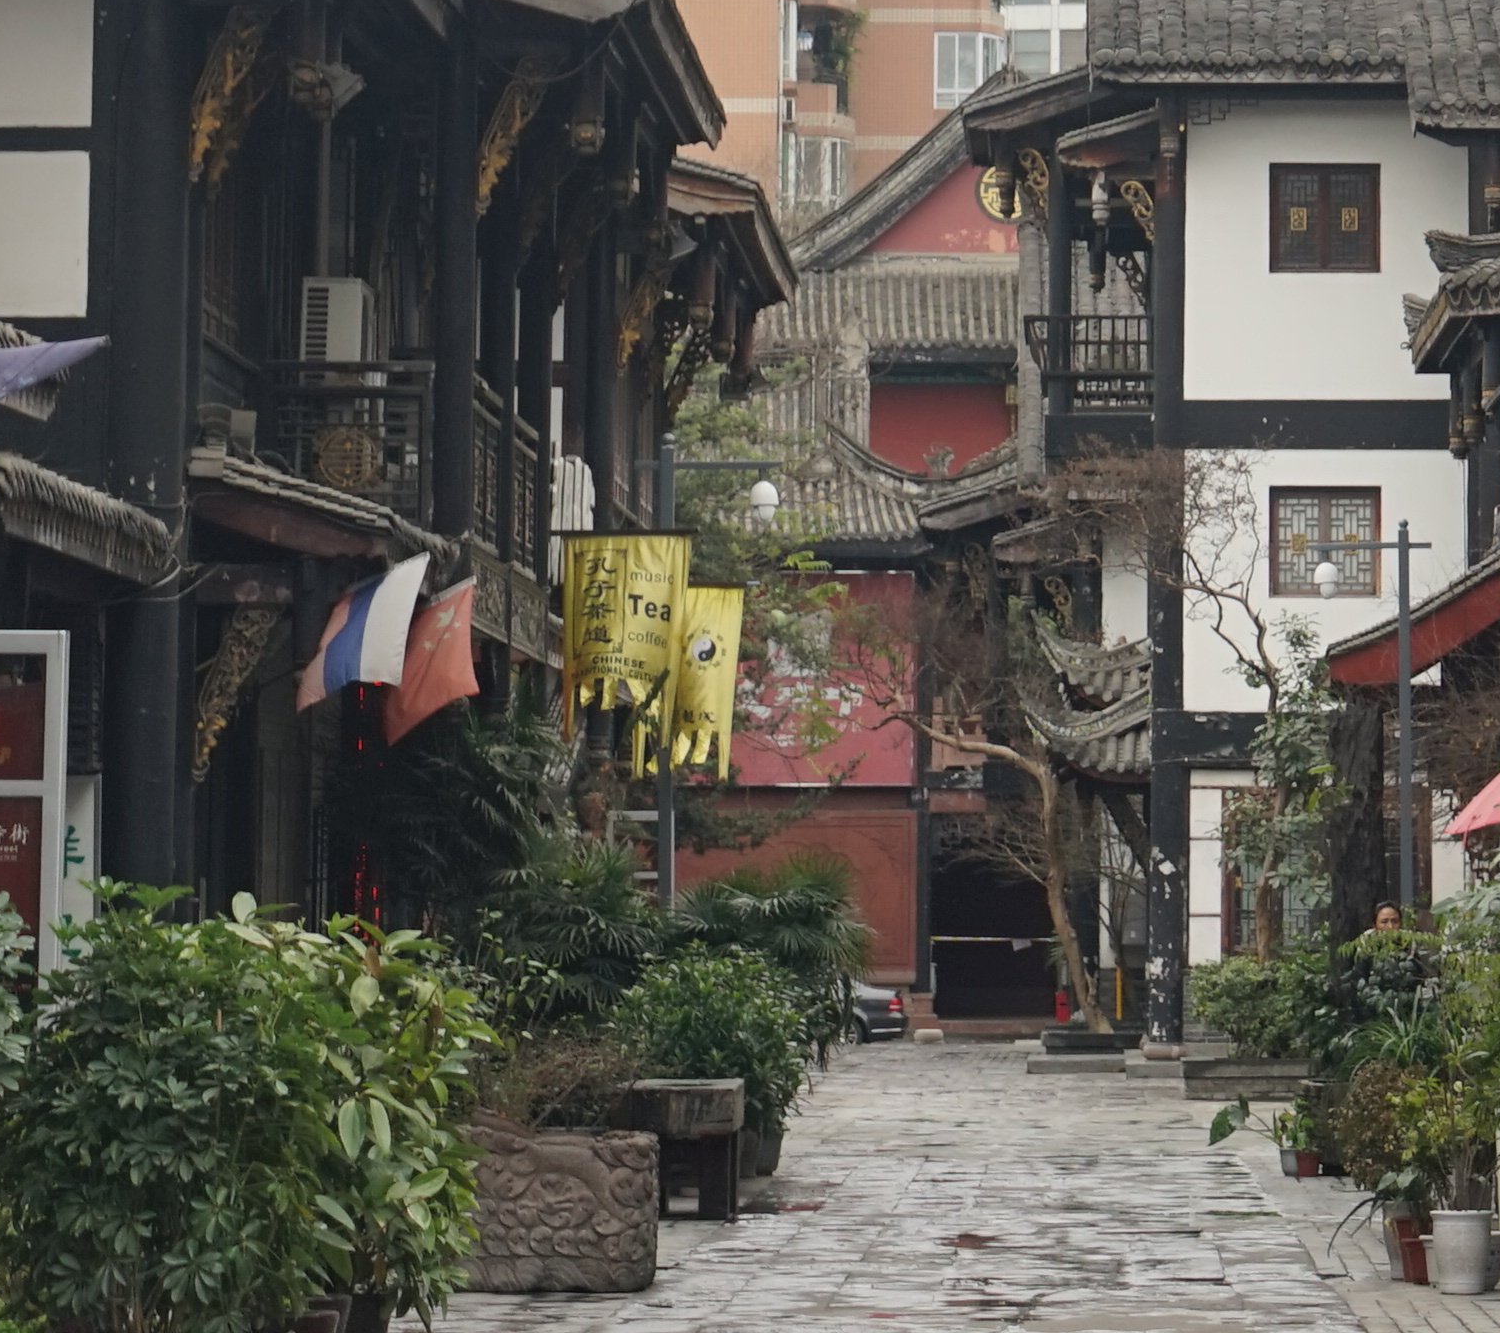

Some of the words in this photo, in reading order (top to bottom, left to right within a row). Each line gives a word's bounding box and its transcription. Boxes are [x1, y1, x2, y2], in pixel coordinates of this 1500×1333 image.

[629, 572, 674, 584] music
[581, 557, 617, 645] 孔子茶道
[628, 594, 671, 622] Tea
[627, 630, 668, 649] coffee
[592, 655, 645, 670] CHINESE
